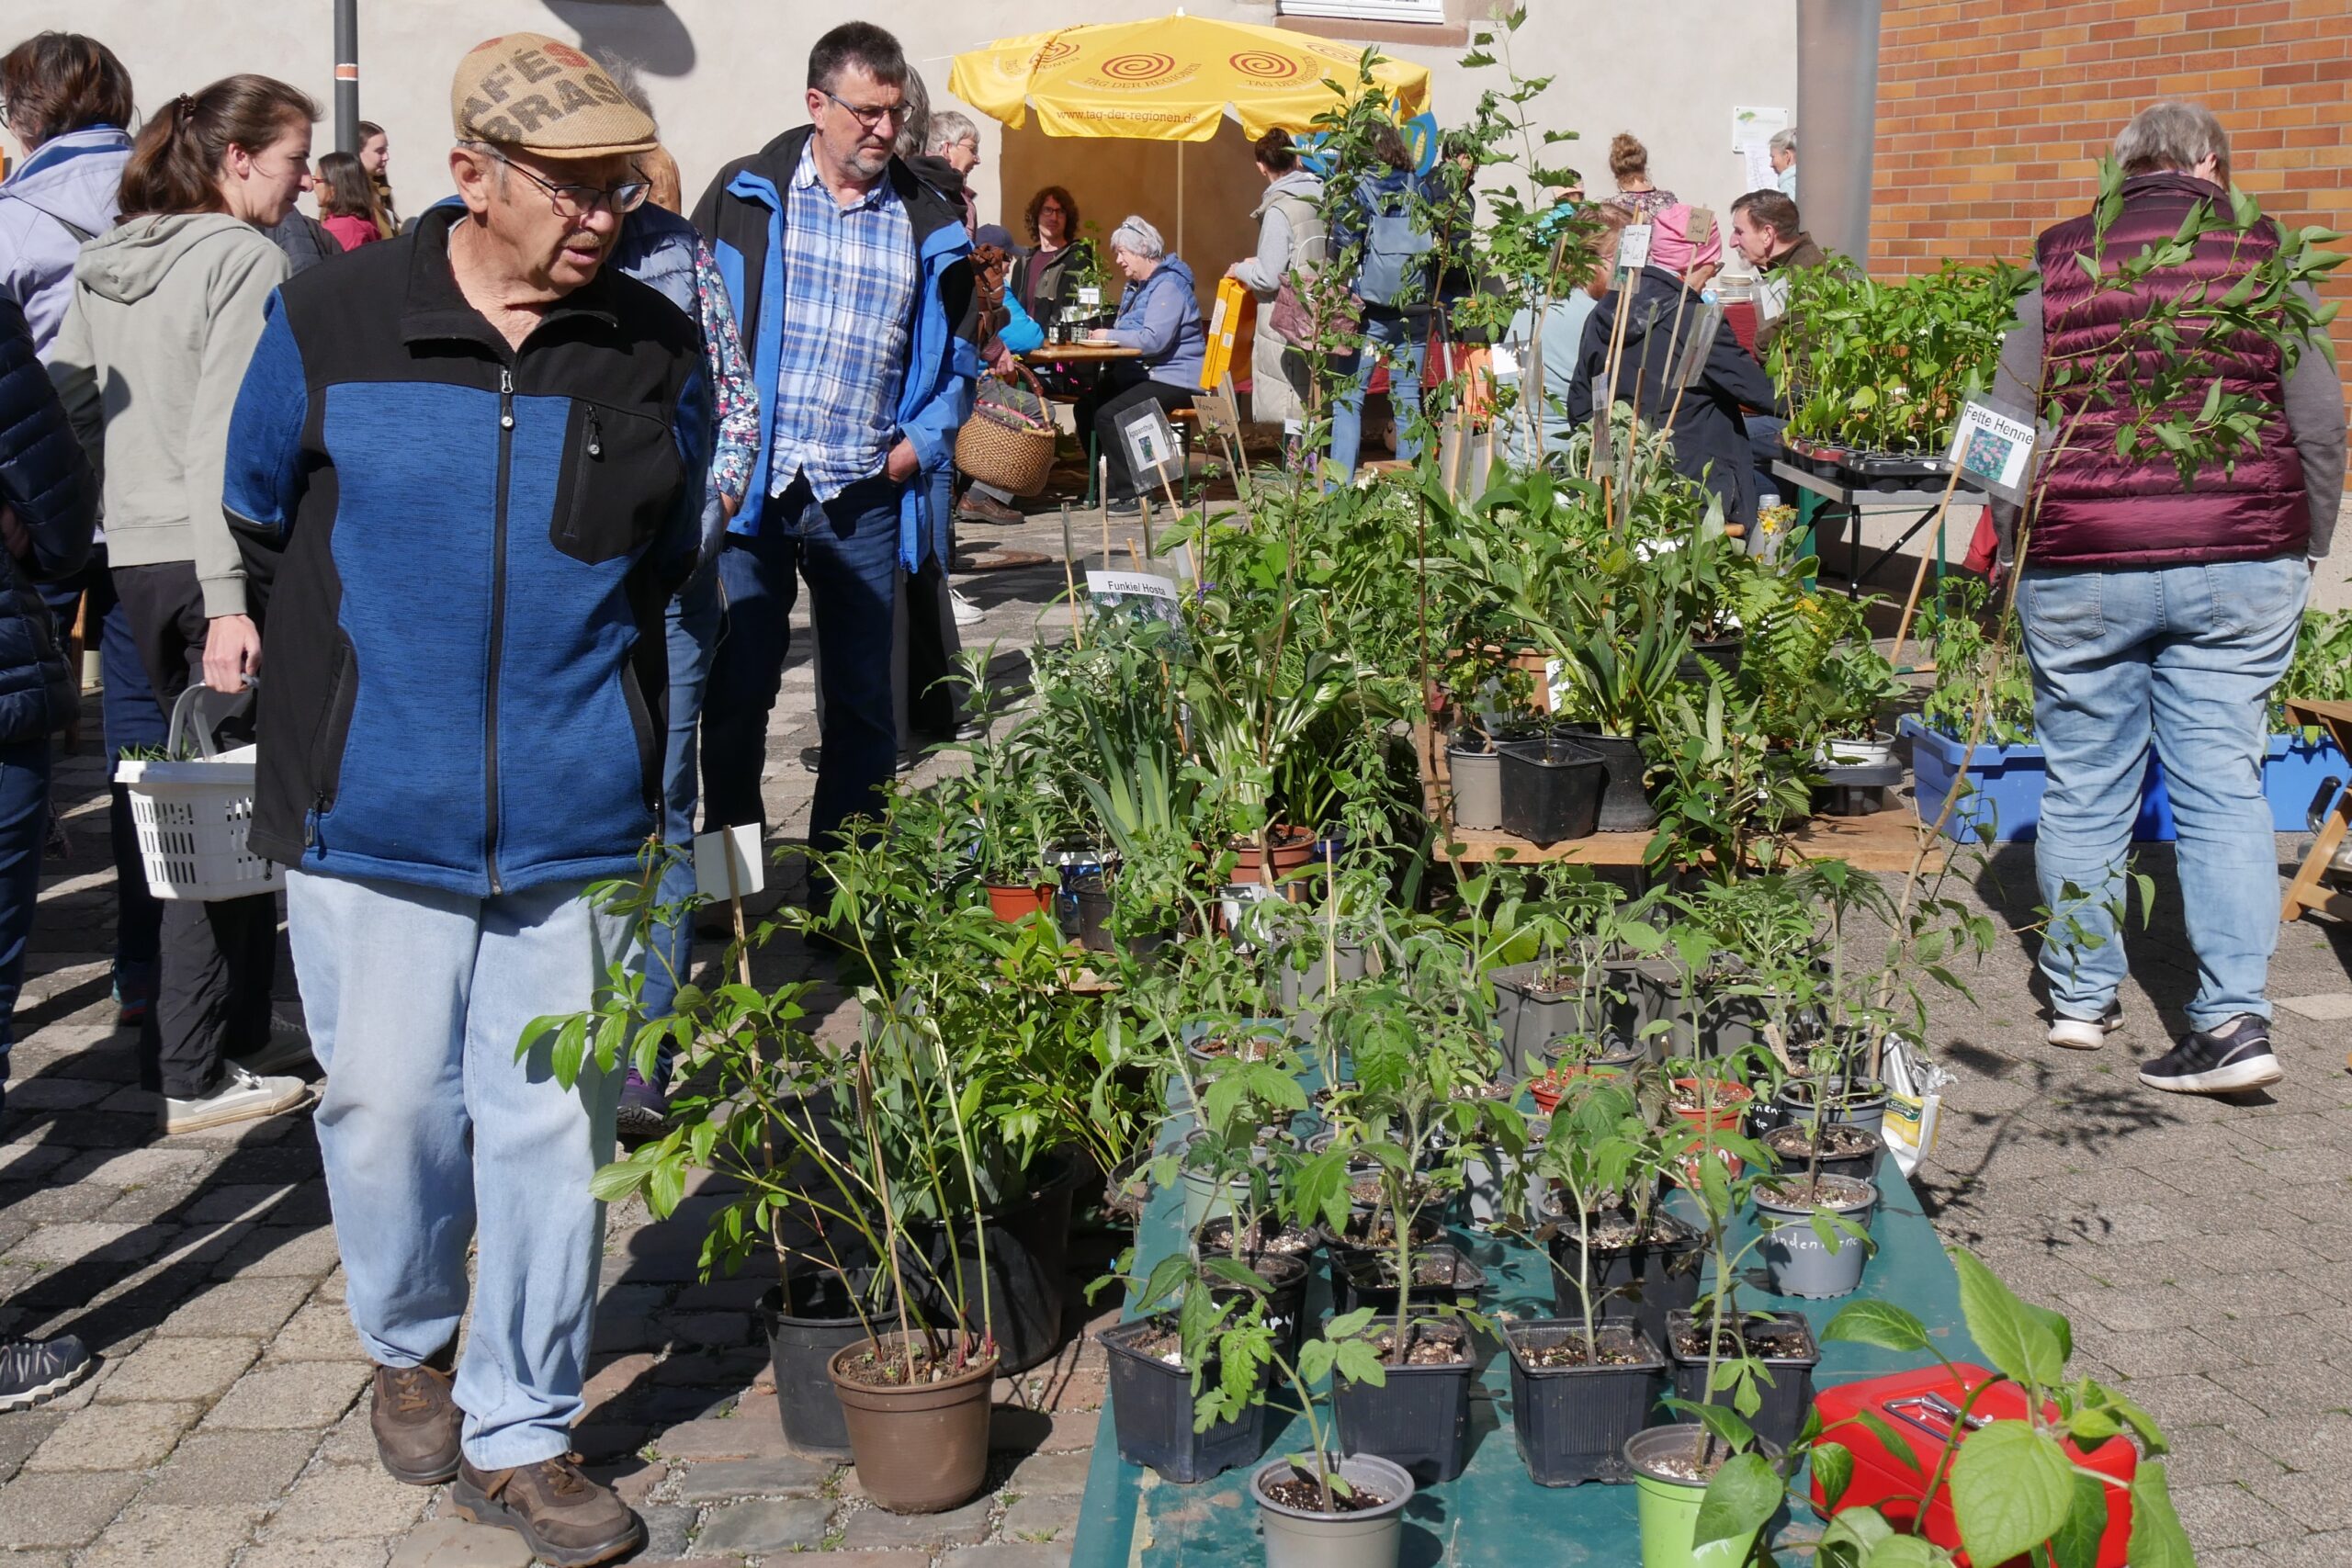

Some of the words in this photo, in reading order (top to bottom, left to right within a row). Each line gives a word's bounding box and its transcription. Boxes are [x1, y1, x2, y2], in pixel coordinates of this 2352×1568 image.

[1083, 76, 1108, 87] TAG
[1145, 62, 1203, 87] REGIONEN
[461, 48, 562, 129] AFÉ
[1056, 108, 1198, 125] www.tag-der-regionen.de
[1964, 404, 1992, 427] Fette
[1994, 418, 2033, 445] Henne
[1142, 583, 1167, 596] Hosta
[1748, 1102, 1784, 1116] onen-
